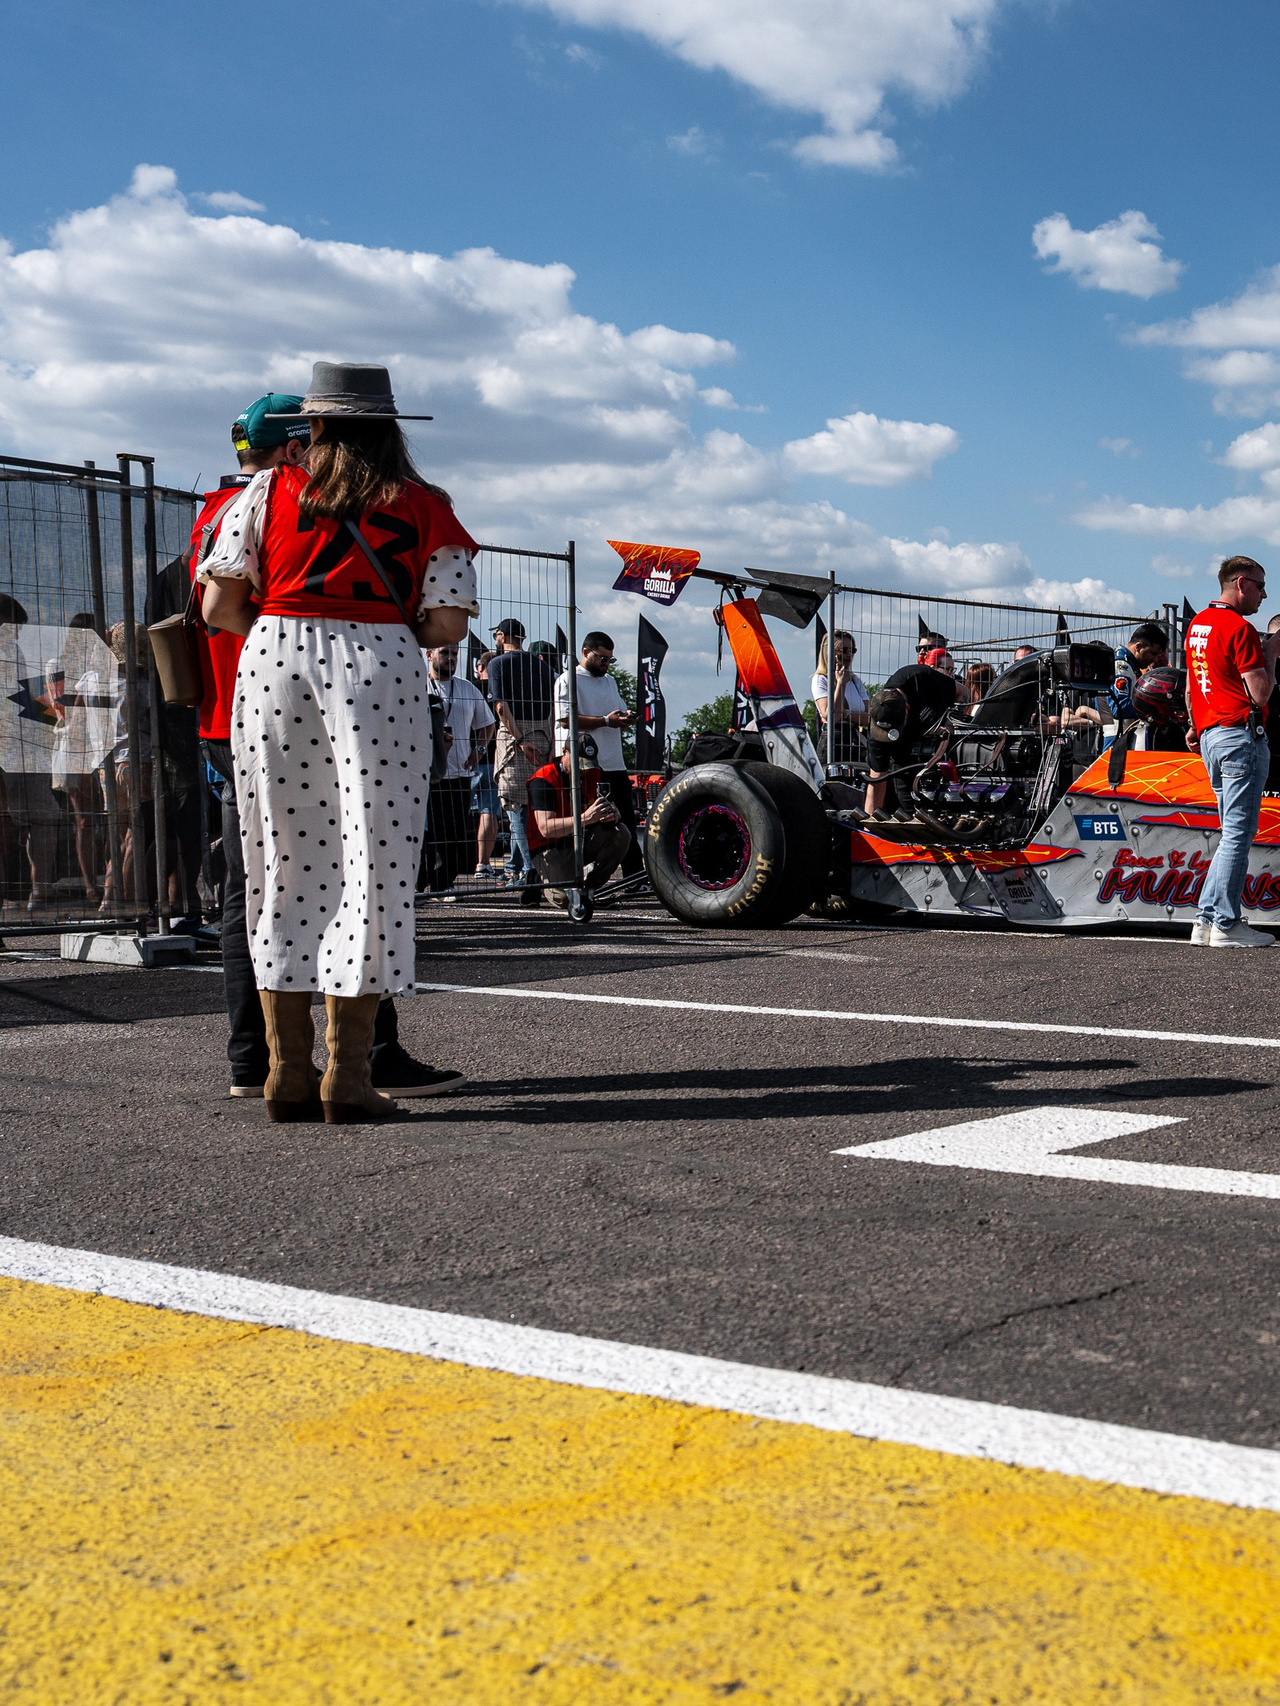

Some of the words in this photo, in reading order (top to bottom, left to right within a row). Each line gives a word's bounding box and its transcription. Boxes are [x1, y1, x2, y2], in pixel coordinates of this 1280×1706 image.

[288, 428, 311, 437] aramc
[644, 578, 676, 594] GORILLA
[648, 778, 689, 842] Hoosier
[1093, 821, 1119, 835] ВТБ
[727, 853, 774, 917] Hoosier
